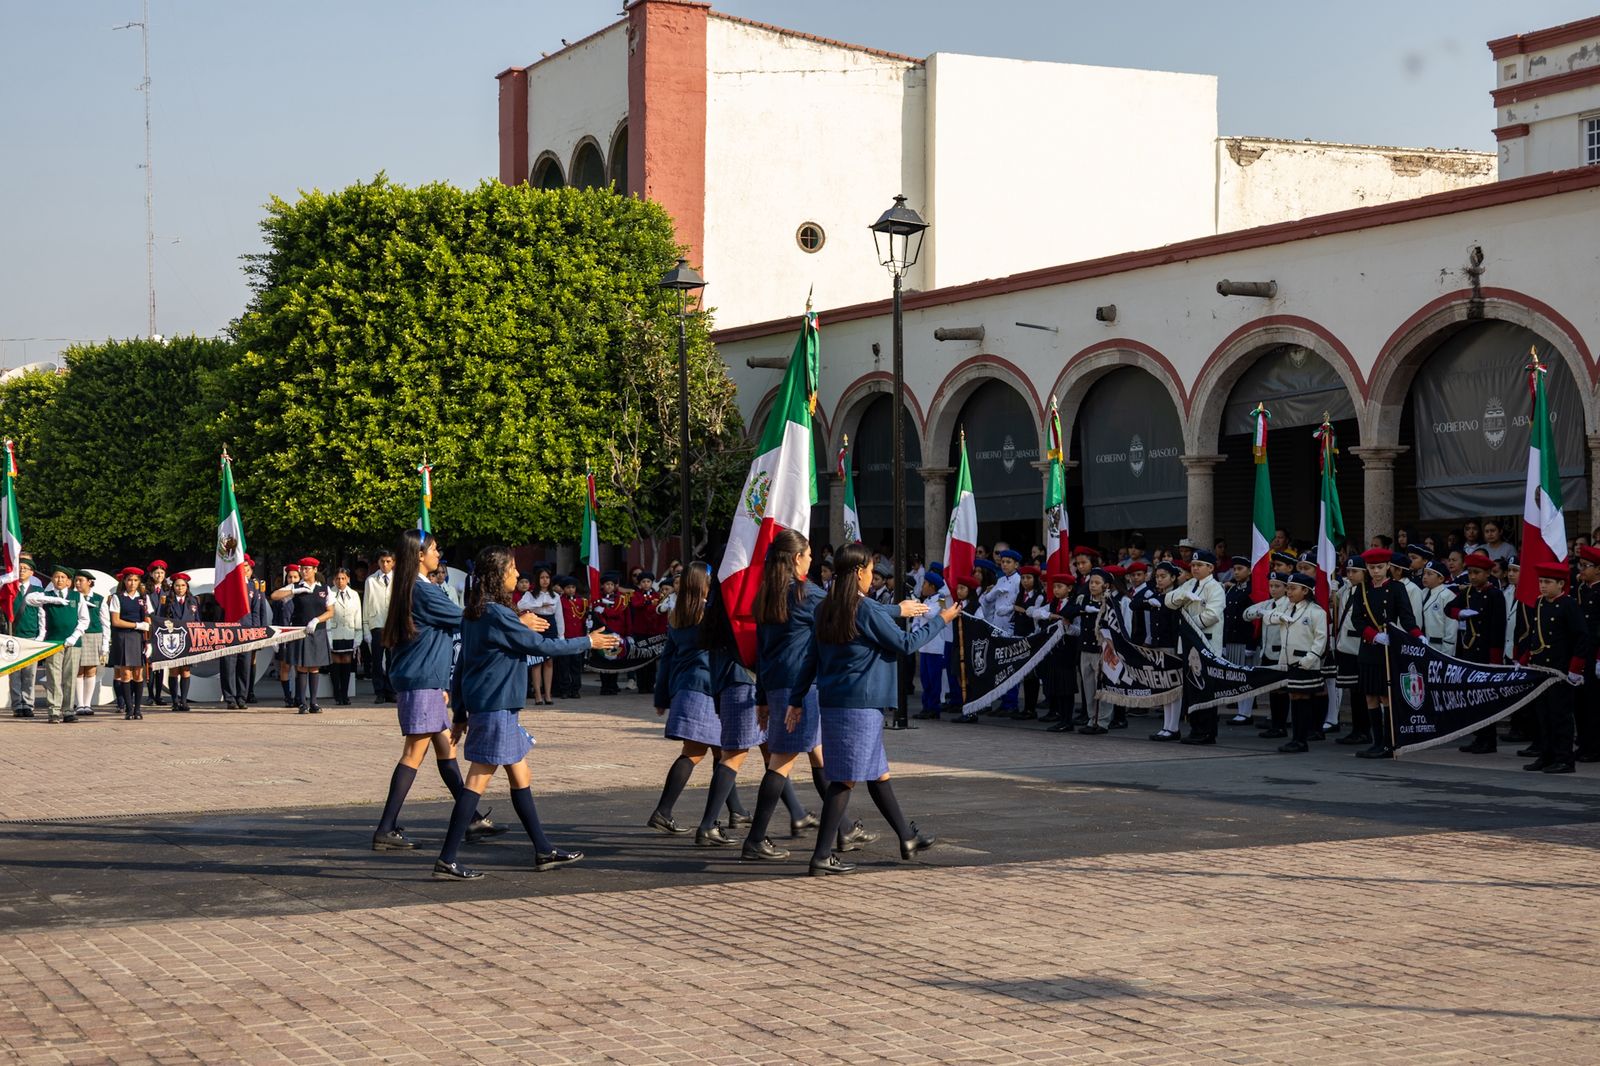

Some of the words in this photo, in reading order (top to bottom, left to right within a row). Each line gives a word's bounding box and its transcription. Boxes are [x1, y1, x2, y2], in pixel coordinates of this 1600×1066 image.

[1432, 419, 1479, 433] GOBIERNO
[1511, 411, 1557, 428] ABAO
[975, 450, 1001, 460] GOBIERNO
[1014, 449, 1040, 460] ABASOLO
[1095, 452, 1127, 464] GOBIERNO
[1148, 446, 1178, 459] ABASOLO
[237, 627, 268, 642] URIBE
[1427, 660, 1443, 684] ESC.
[1444, 688, 1467, 711] CARLOS
[1466, 686, 1499, 707] CORTES
[1410, 715, 1428, 725] GTO.
